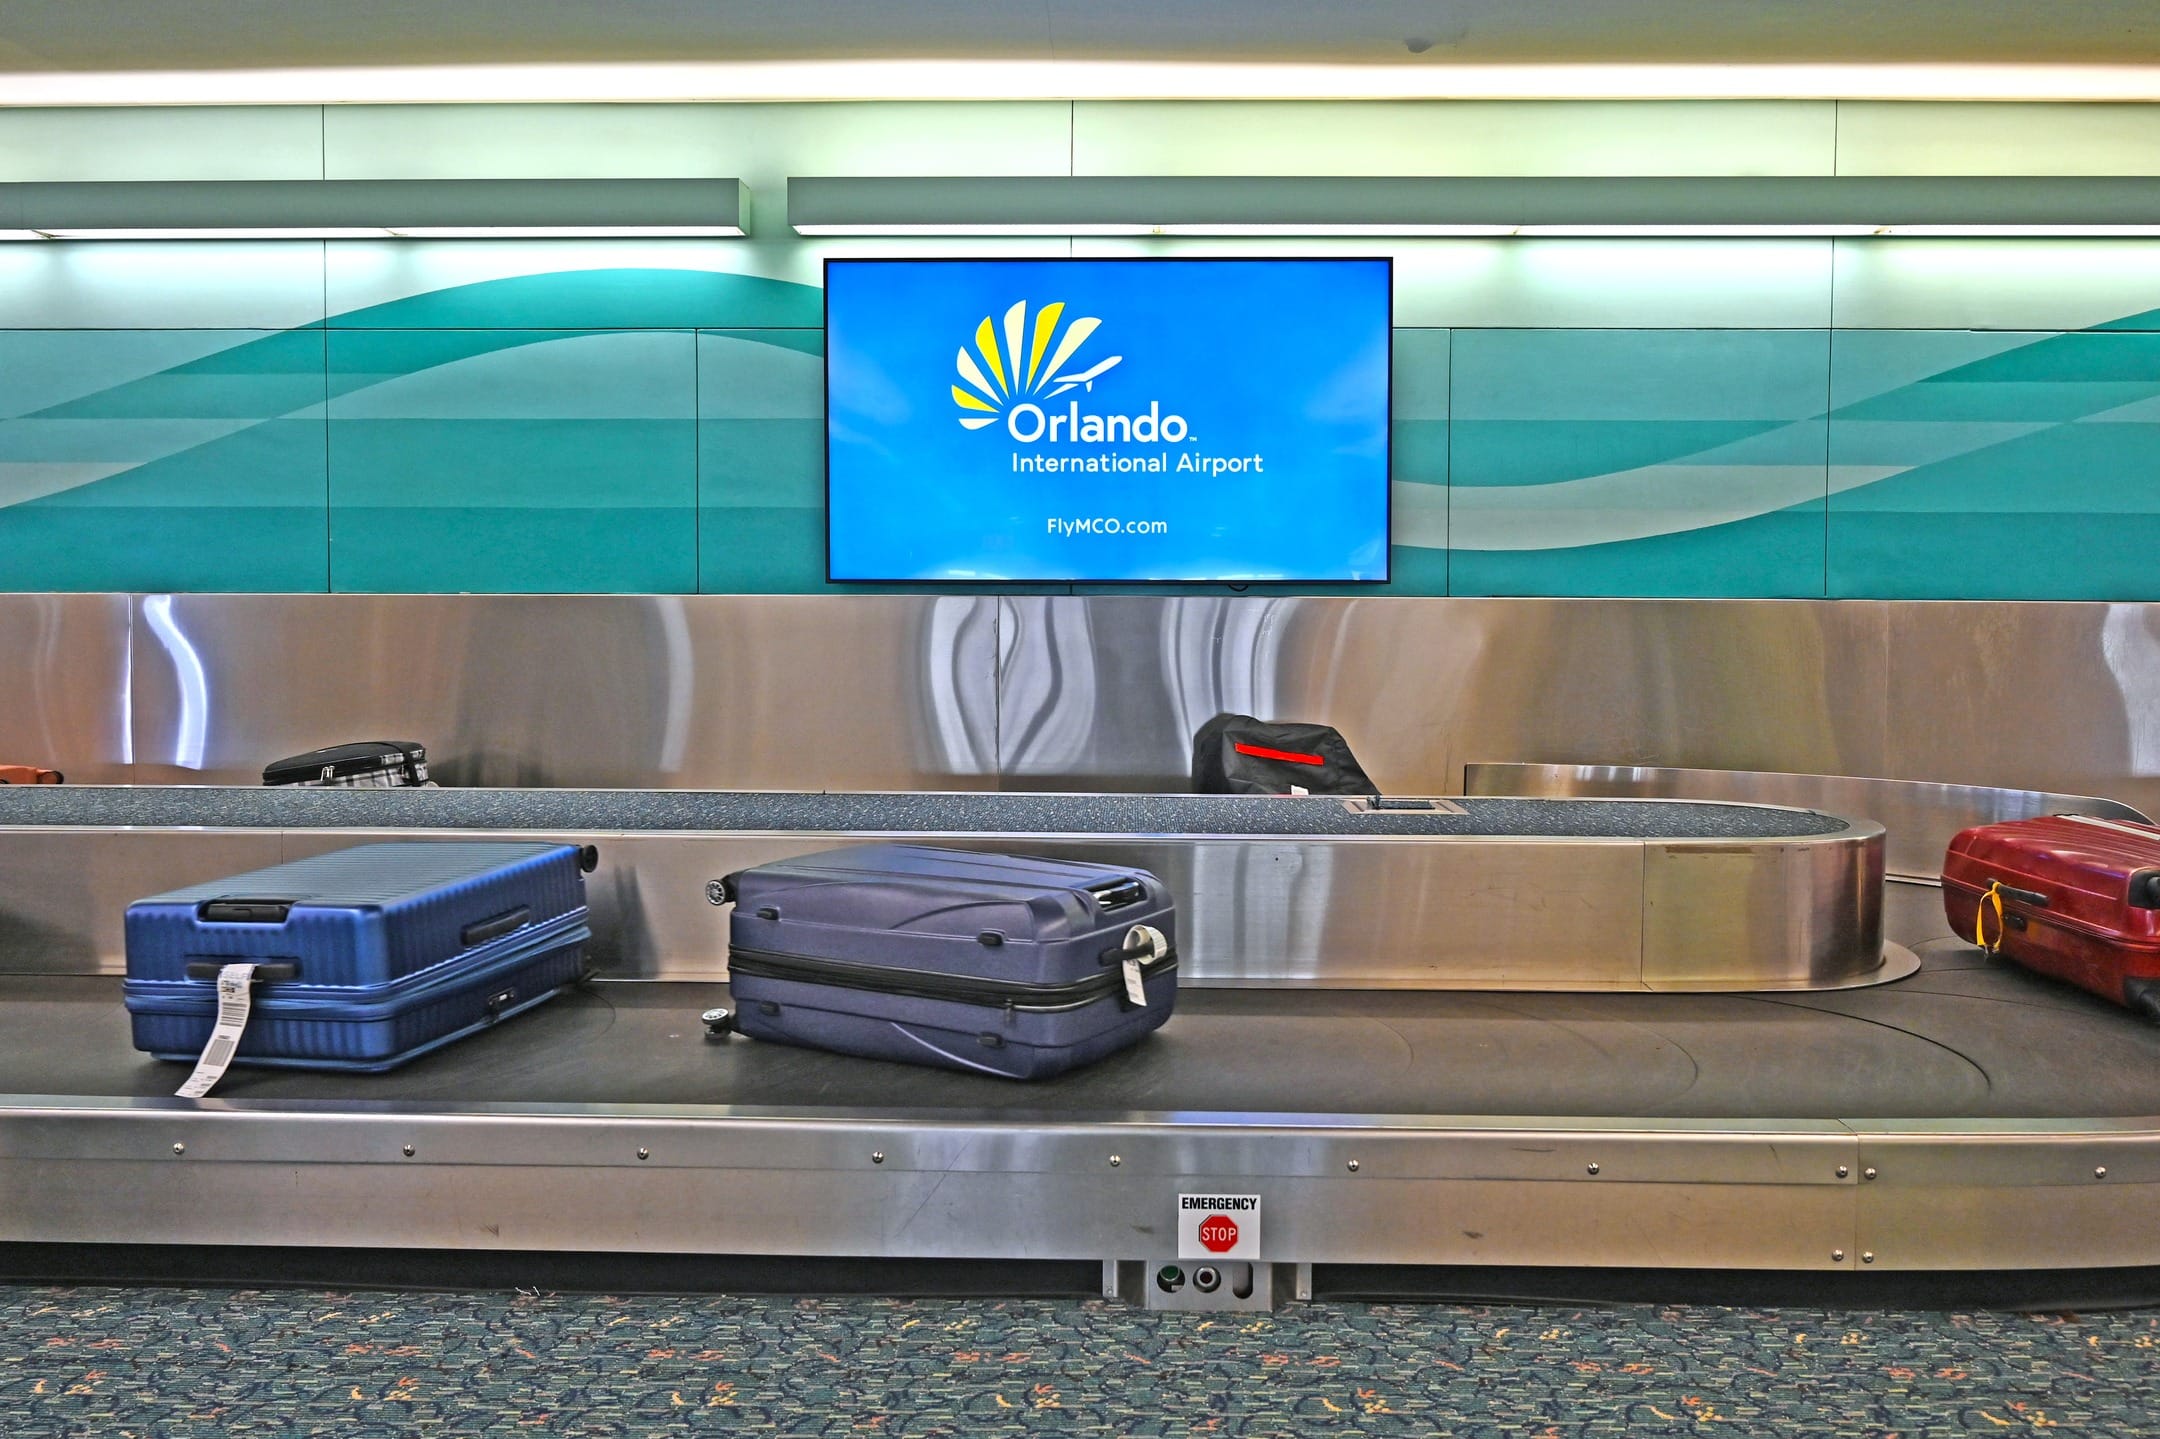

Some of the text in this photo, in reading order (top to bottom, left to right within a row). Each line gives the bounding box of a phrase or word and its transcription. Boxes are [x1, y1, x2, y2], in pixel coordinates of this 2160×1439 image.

[1007, 400, 1188, 443] Orlando
[1012, 452, 1264, 477] International Airport
[1047, 518, 1167, 537] FlyMCO.com
[1181, 1197, 1257, 1211] EMERGENCY
[1202, 1227, 1237, 1241] STOP
